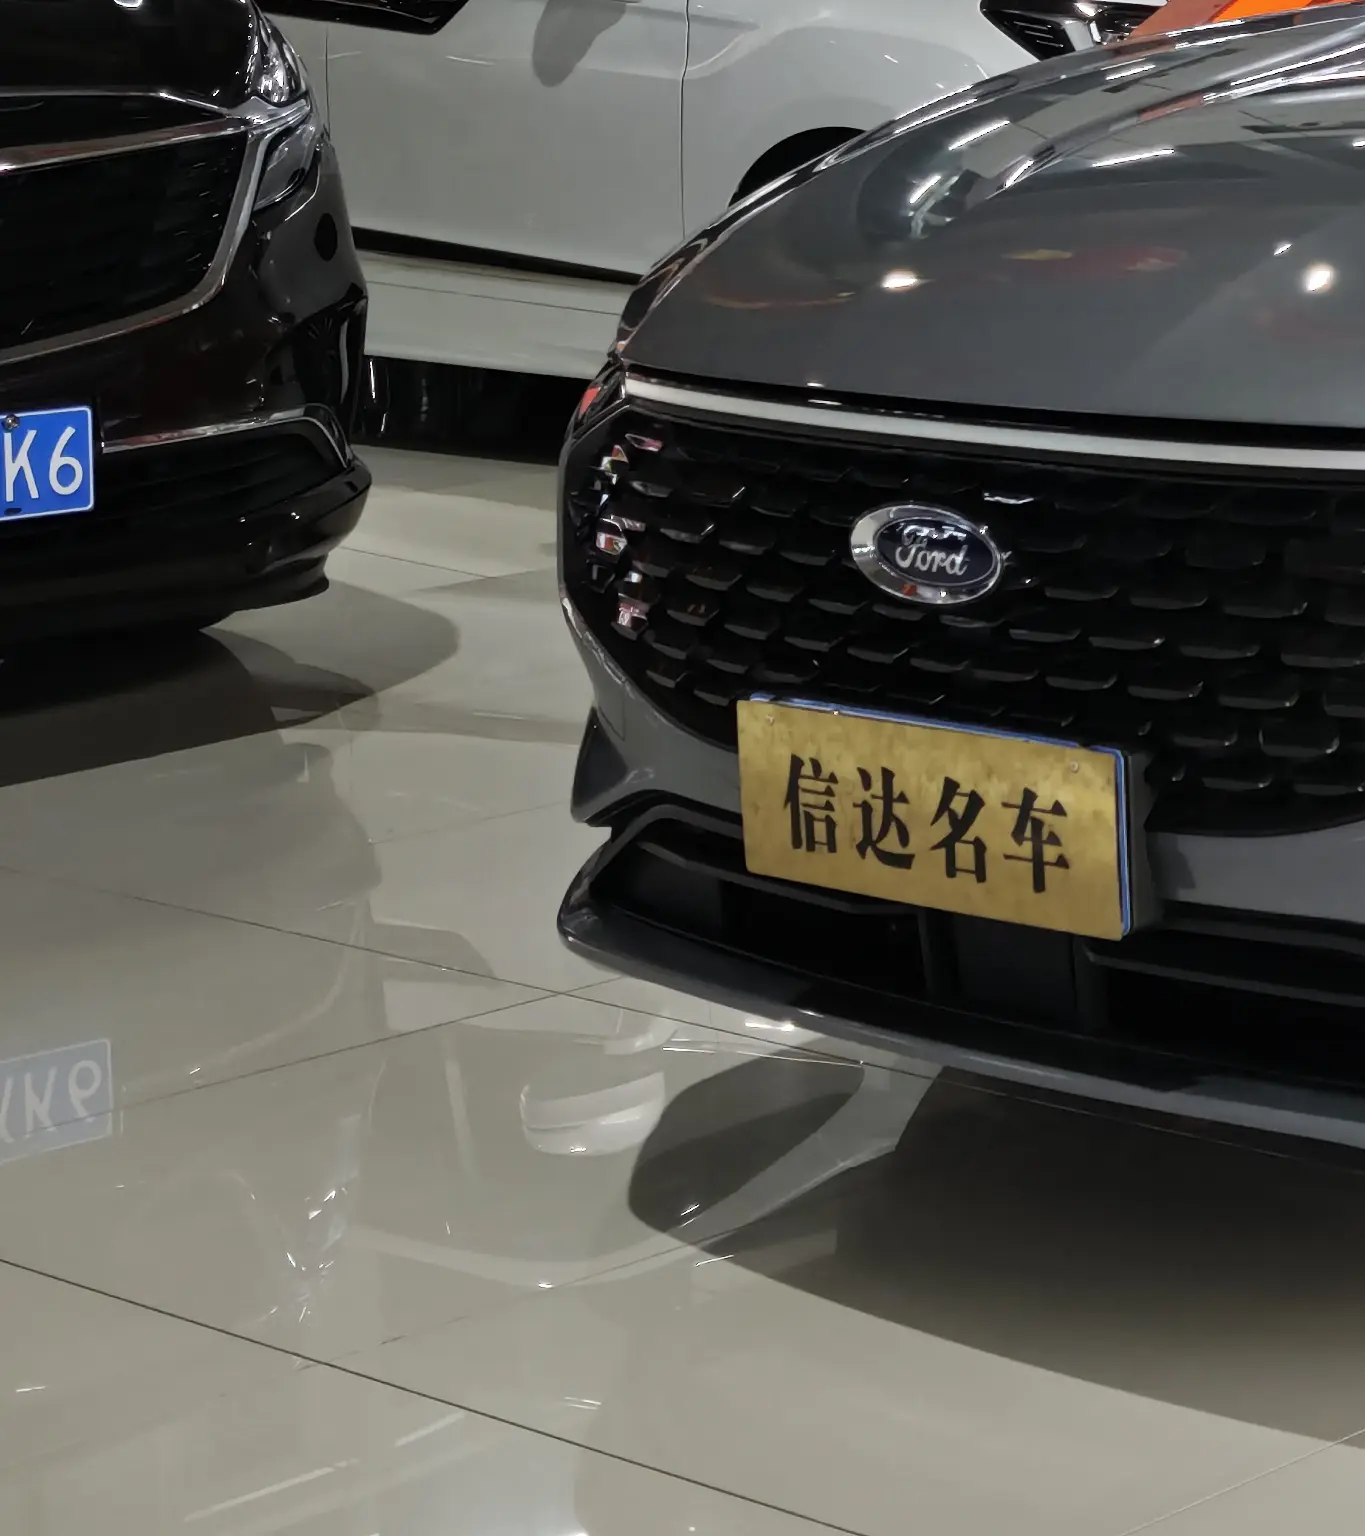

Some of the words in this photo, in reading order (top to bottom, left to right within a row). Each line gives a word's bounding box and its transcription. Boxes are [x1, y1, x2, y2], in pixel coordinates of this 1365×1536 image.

[4, 426, 83, 502] K6
[895, 525, 969, 576] Ford
[783, 753, 1070, 894] 信达名车
